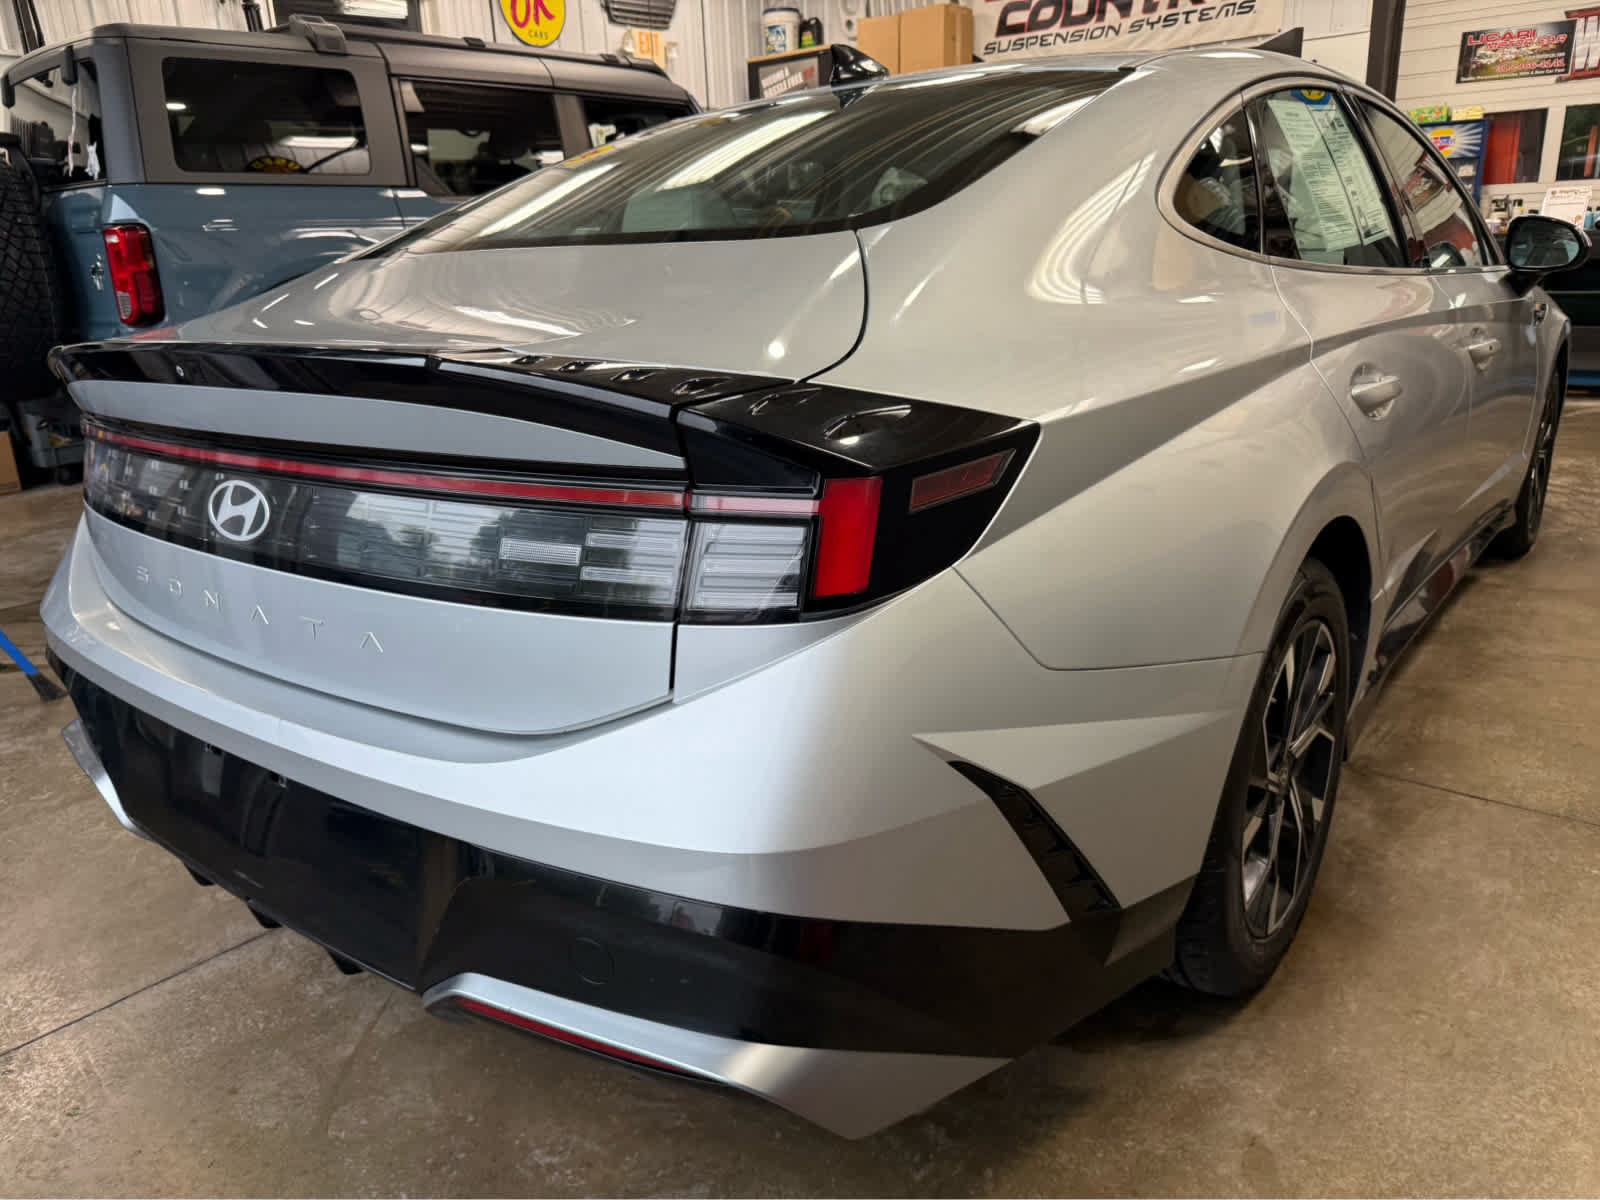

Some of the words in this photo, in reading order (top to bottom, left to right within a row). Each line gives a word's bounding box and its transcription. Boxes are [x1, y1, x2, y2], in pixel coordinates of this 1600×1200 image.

[528, 29, 549, 40] CARS
[984, 22, 1122, 55] SUSPENSION
[1128, 1, 1256, 34] SYSTEMS
[1467, 29, 1537, 46] LICARI
[136, 565, 384, 653] SONATA
